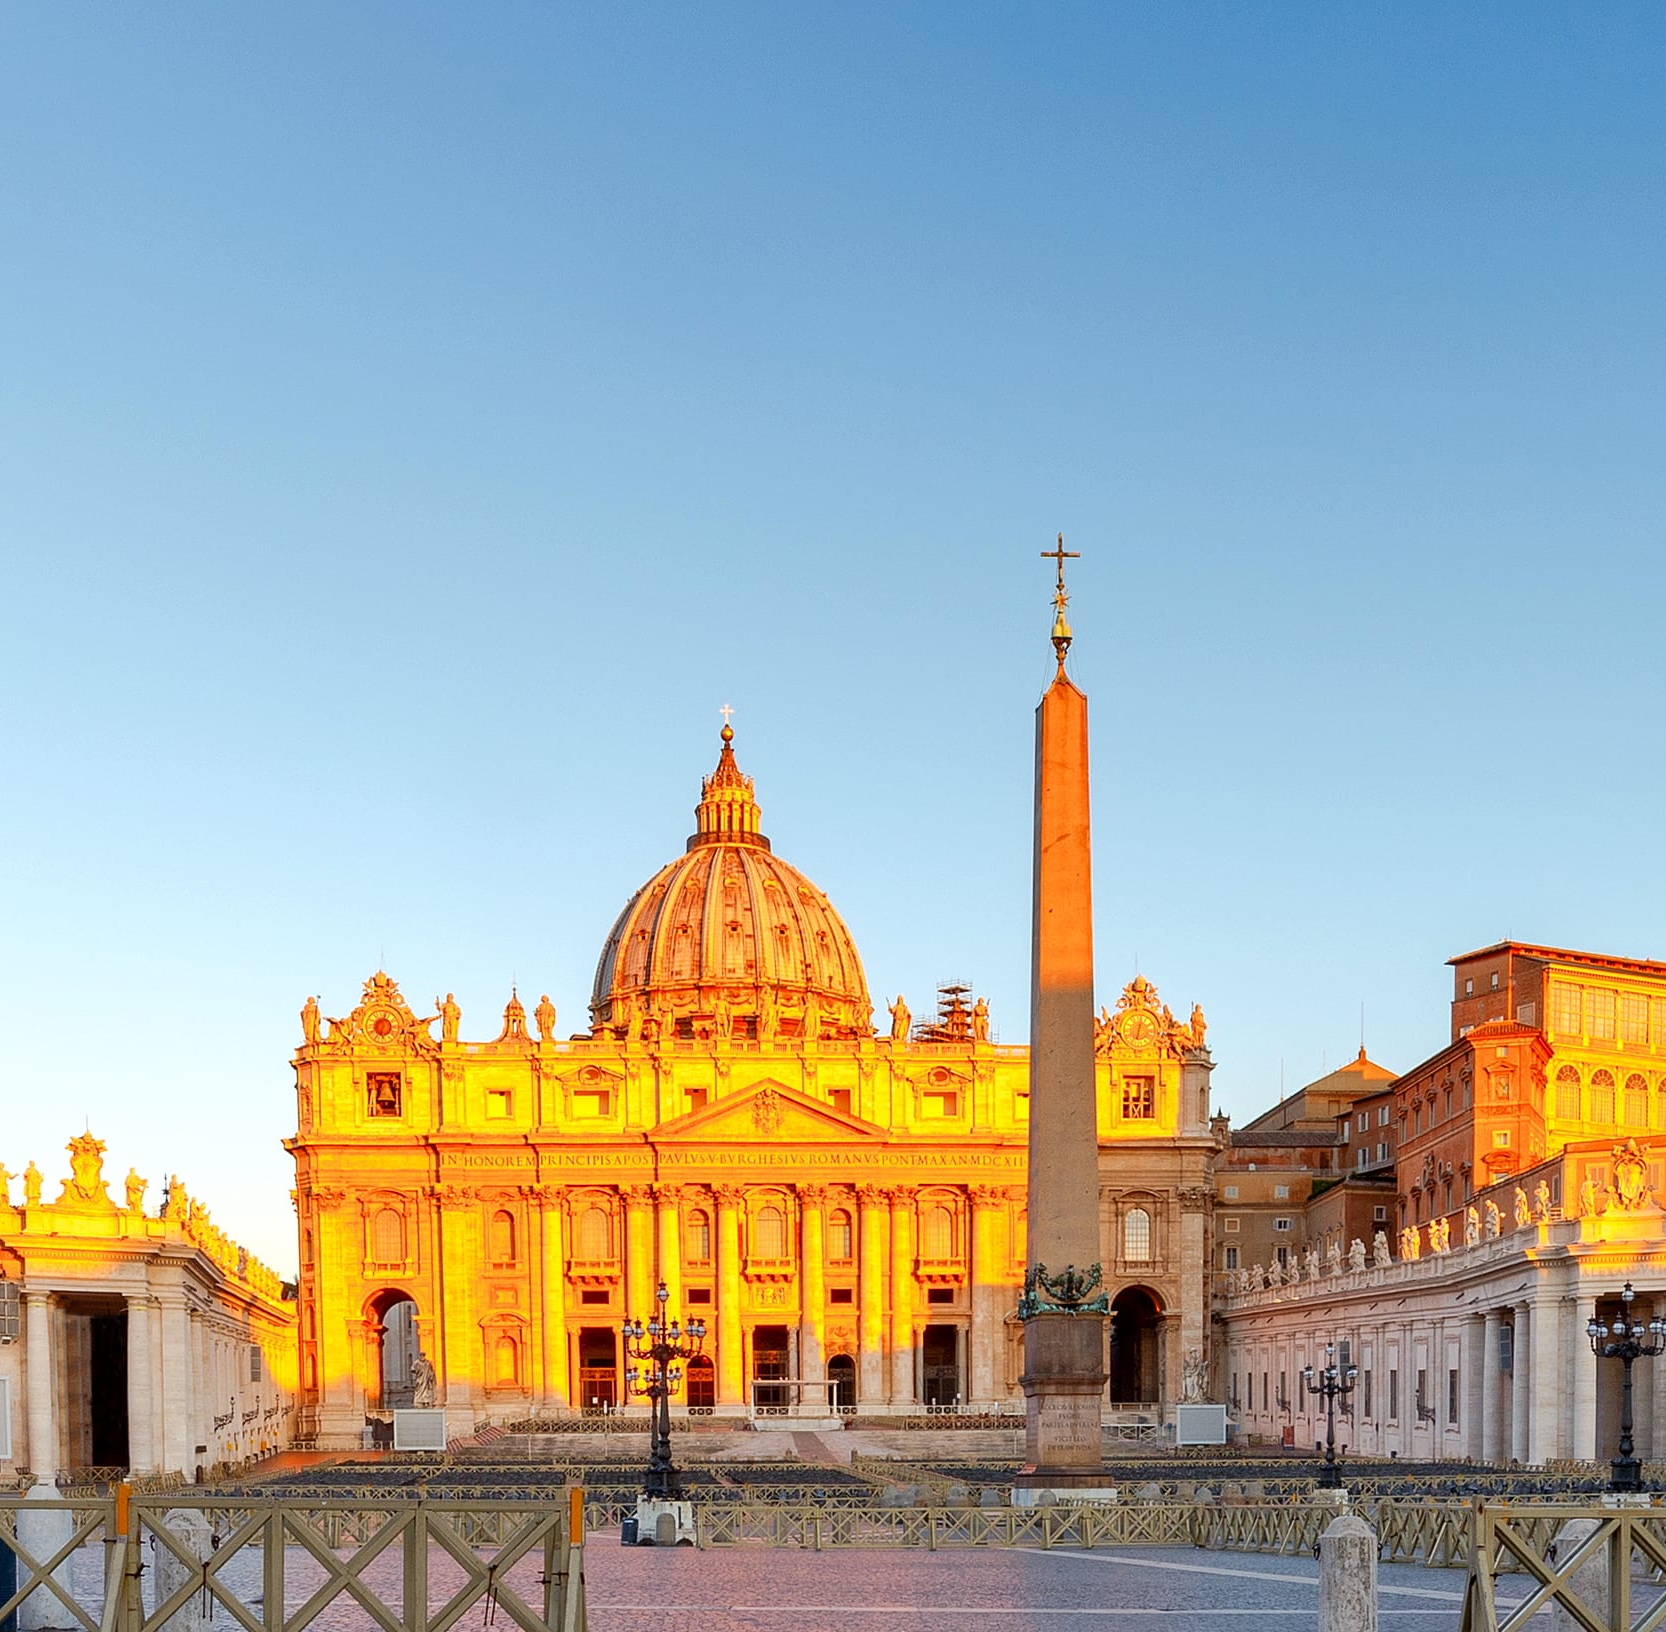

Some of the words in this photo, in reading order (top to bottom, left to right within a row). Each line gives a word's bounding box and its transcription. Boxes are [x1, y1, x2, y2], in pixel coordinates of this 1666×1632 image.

[441, 1154, 457, 1165] IN
[464, 1155, 535, 1166] HONOREM
[540, 1154, 611, 1166] PRINCIPIS
[659, 1154, 706, 1164] PAVLVS
[720, 1153, 805, 1164] BVRGHESIVS
[809, 1153, 879, 1165] ROMANVS
